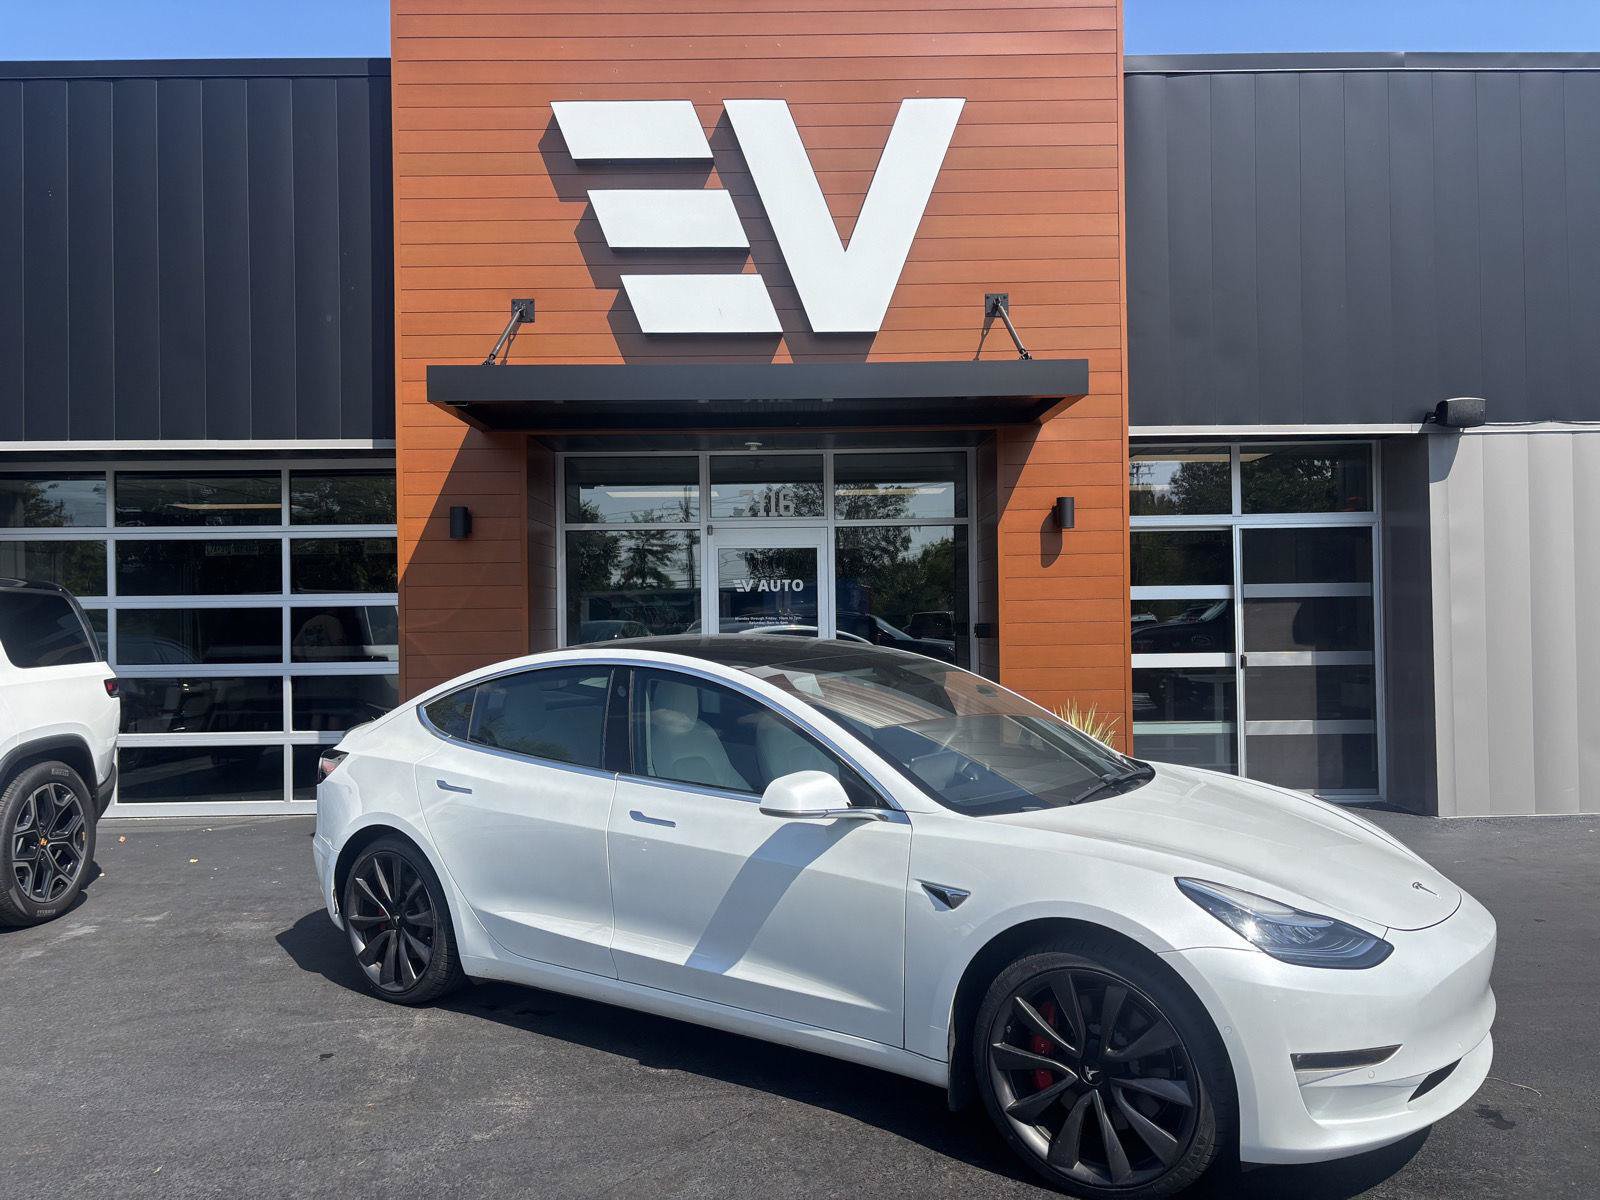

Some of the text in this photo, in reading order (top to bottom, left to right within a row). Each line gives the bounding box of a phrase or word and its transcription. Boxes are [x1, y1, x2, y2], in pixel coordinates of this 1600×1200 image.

[550, 97, 966, 334] EV
[733, 579, 804, 592] EV AUTO
